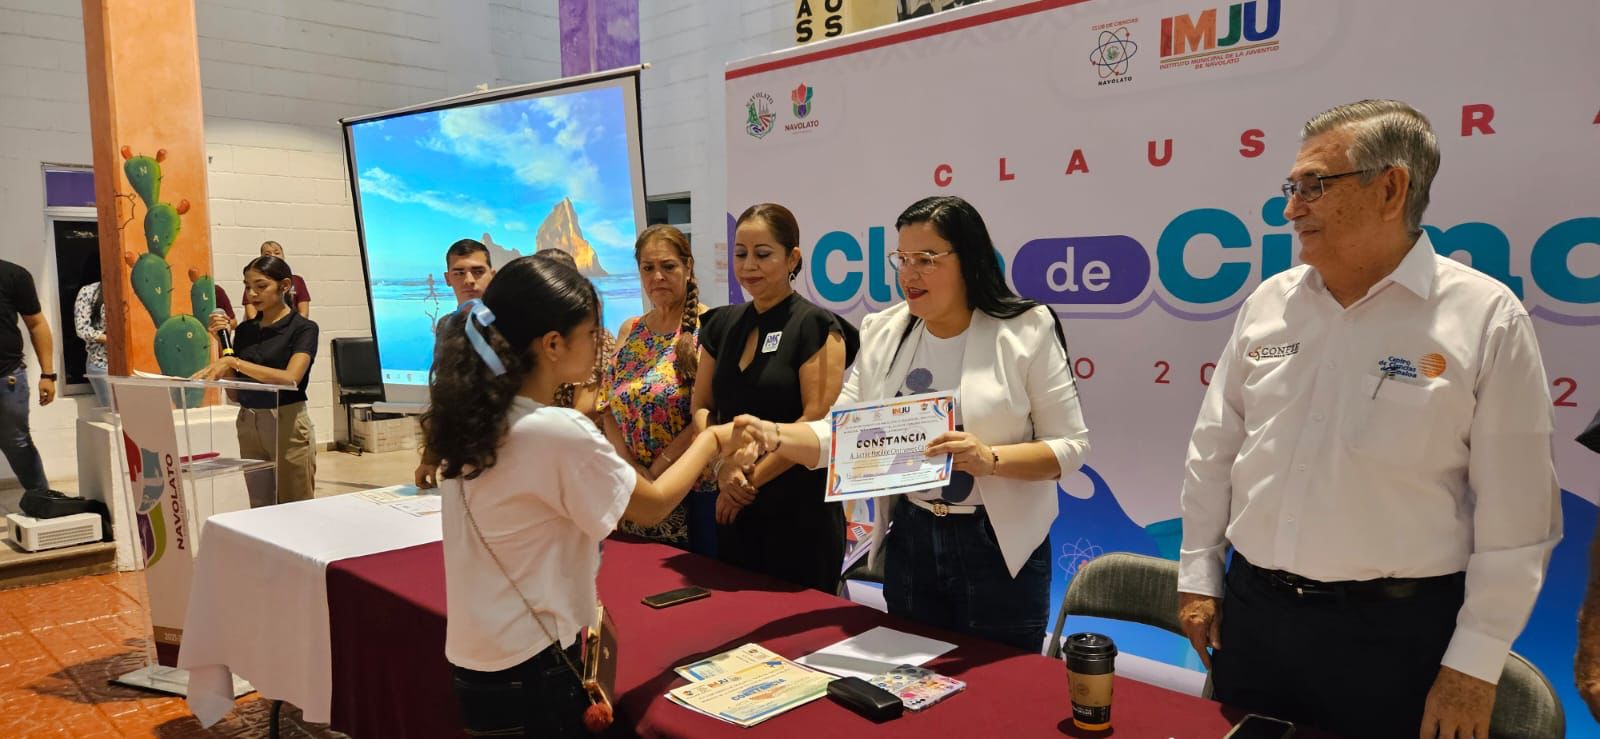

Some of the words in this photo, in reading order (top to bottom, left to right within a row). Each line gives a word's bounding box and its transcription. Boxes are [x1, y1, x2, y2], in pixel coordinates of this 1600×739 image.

[1160, 0, 1281, 58] IMJU
[1159, 60, 1190, 70] INSTITUTO
[1190, 55, 1224, 65] MUNICIPAL
[1245, 46, 1280, 56] JUVENTUD
[1205, 57, 1240, 69] NAVOLATO
[1098, 76, 1132, 86] NAVOLATO
[784, 120, 819, 131] NAVOLATO
[1046, 246, 1111, 292] de
[1388, 356, 1411, 366] Centro
[856, 432, 927, 449] CONSTANCIA
[165, 452, 185, 550] NAVOLATO
